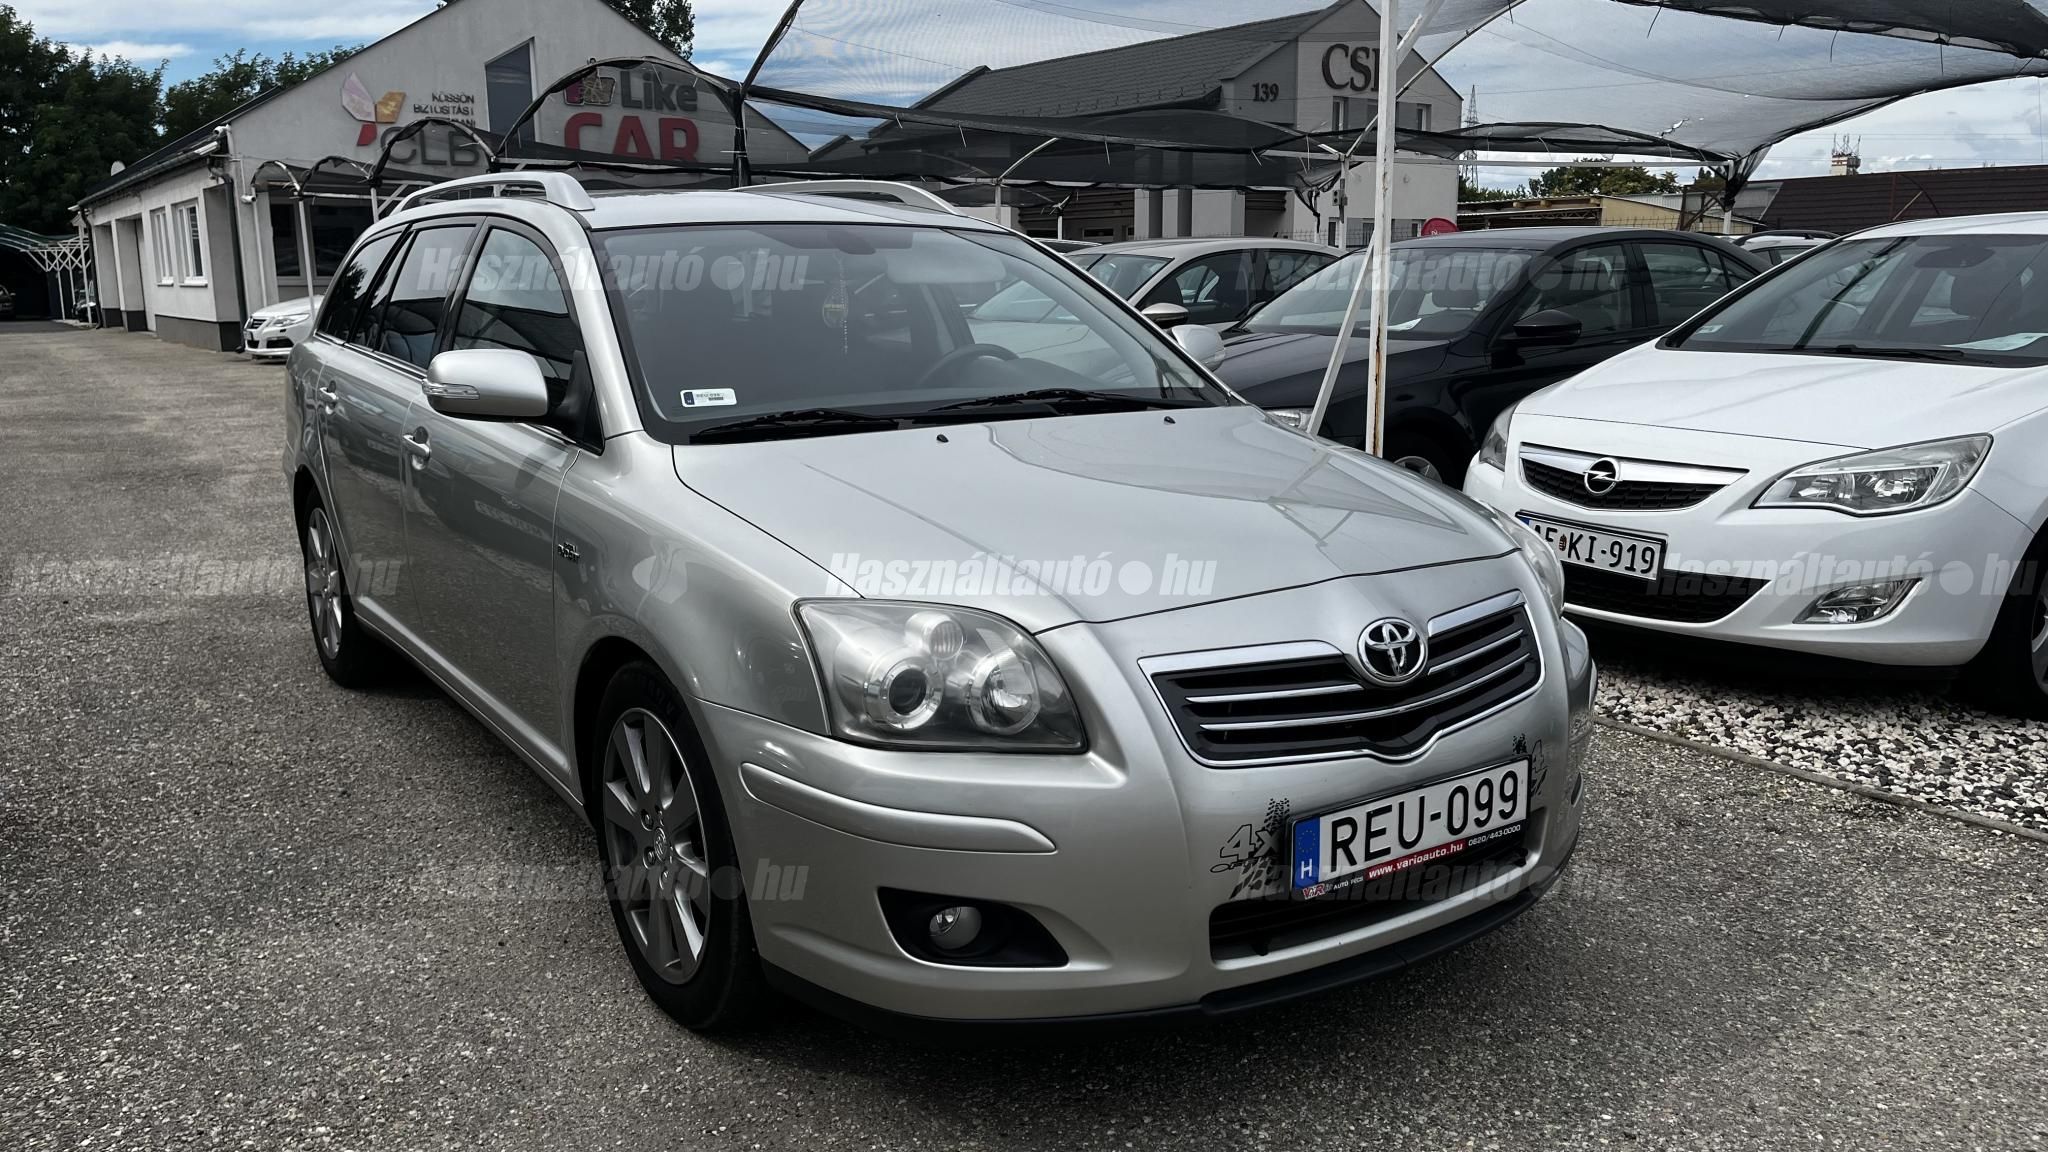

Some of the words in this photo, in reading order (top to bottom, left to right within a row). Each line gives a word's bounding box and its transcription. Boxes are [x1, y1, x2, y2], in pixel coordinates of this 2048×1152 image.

[619, 70, 699, 112] Like
[1252, 82, 1280, 102] 139
[564, 111, 699, 163] CAR
[1567, 531, 1656, 574] KI-919
[1330, 769, 1519, 873] REU-099
[1301, 858, 1313, 879] H
[1368, 842, 1464, 880] www.varioauto.hu
